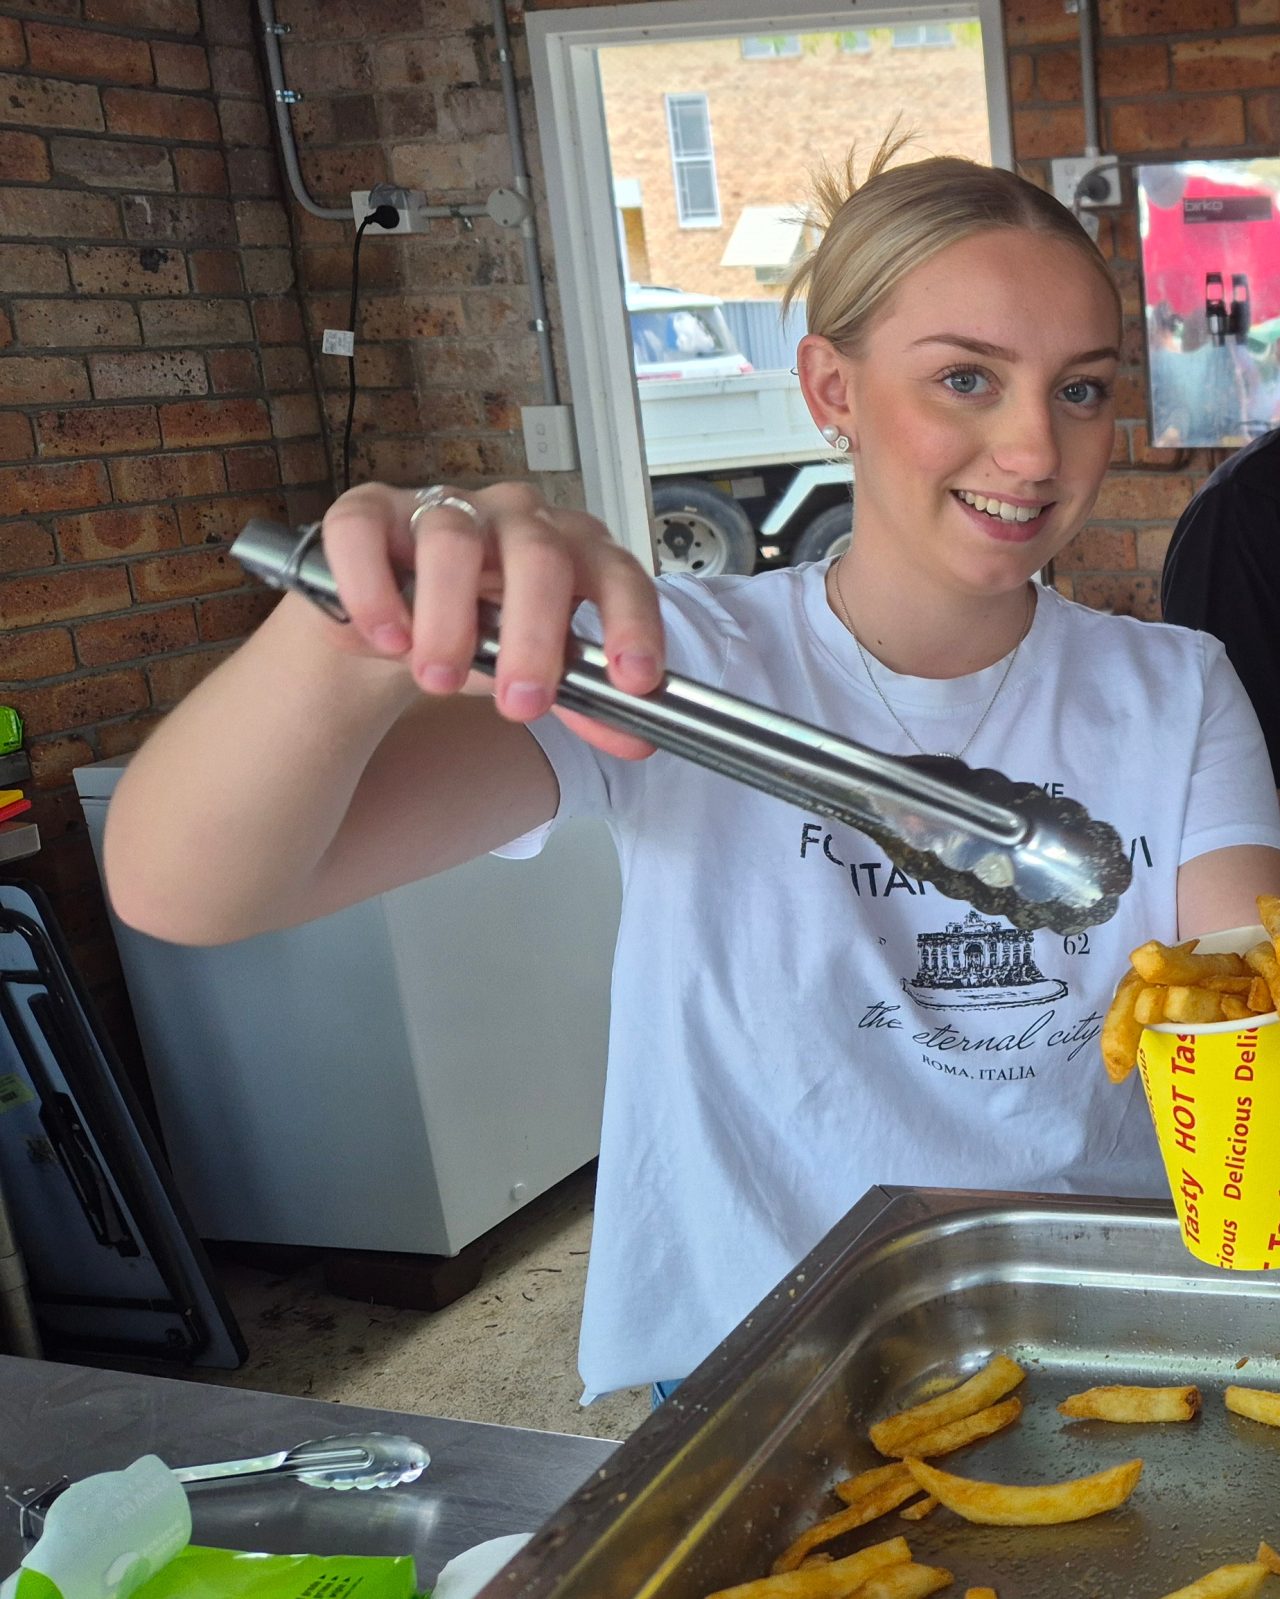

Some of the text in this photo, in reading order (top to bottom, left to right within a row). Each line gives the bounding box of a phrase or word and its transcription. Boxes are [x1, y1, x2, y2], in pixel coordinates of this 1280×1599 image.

[1063, 932, 1091, 955] 62
[857, 1000, 1104, 1062] the eternal city
[979, 1065, 1036, 1081] ITALIA
[1171, 1084, 1197, 1154] HOT
[1223, 1096, 1253, 1201] Delicious
[1179, 1168, 1205, 1245] Tasty
